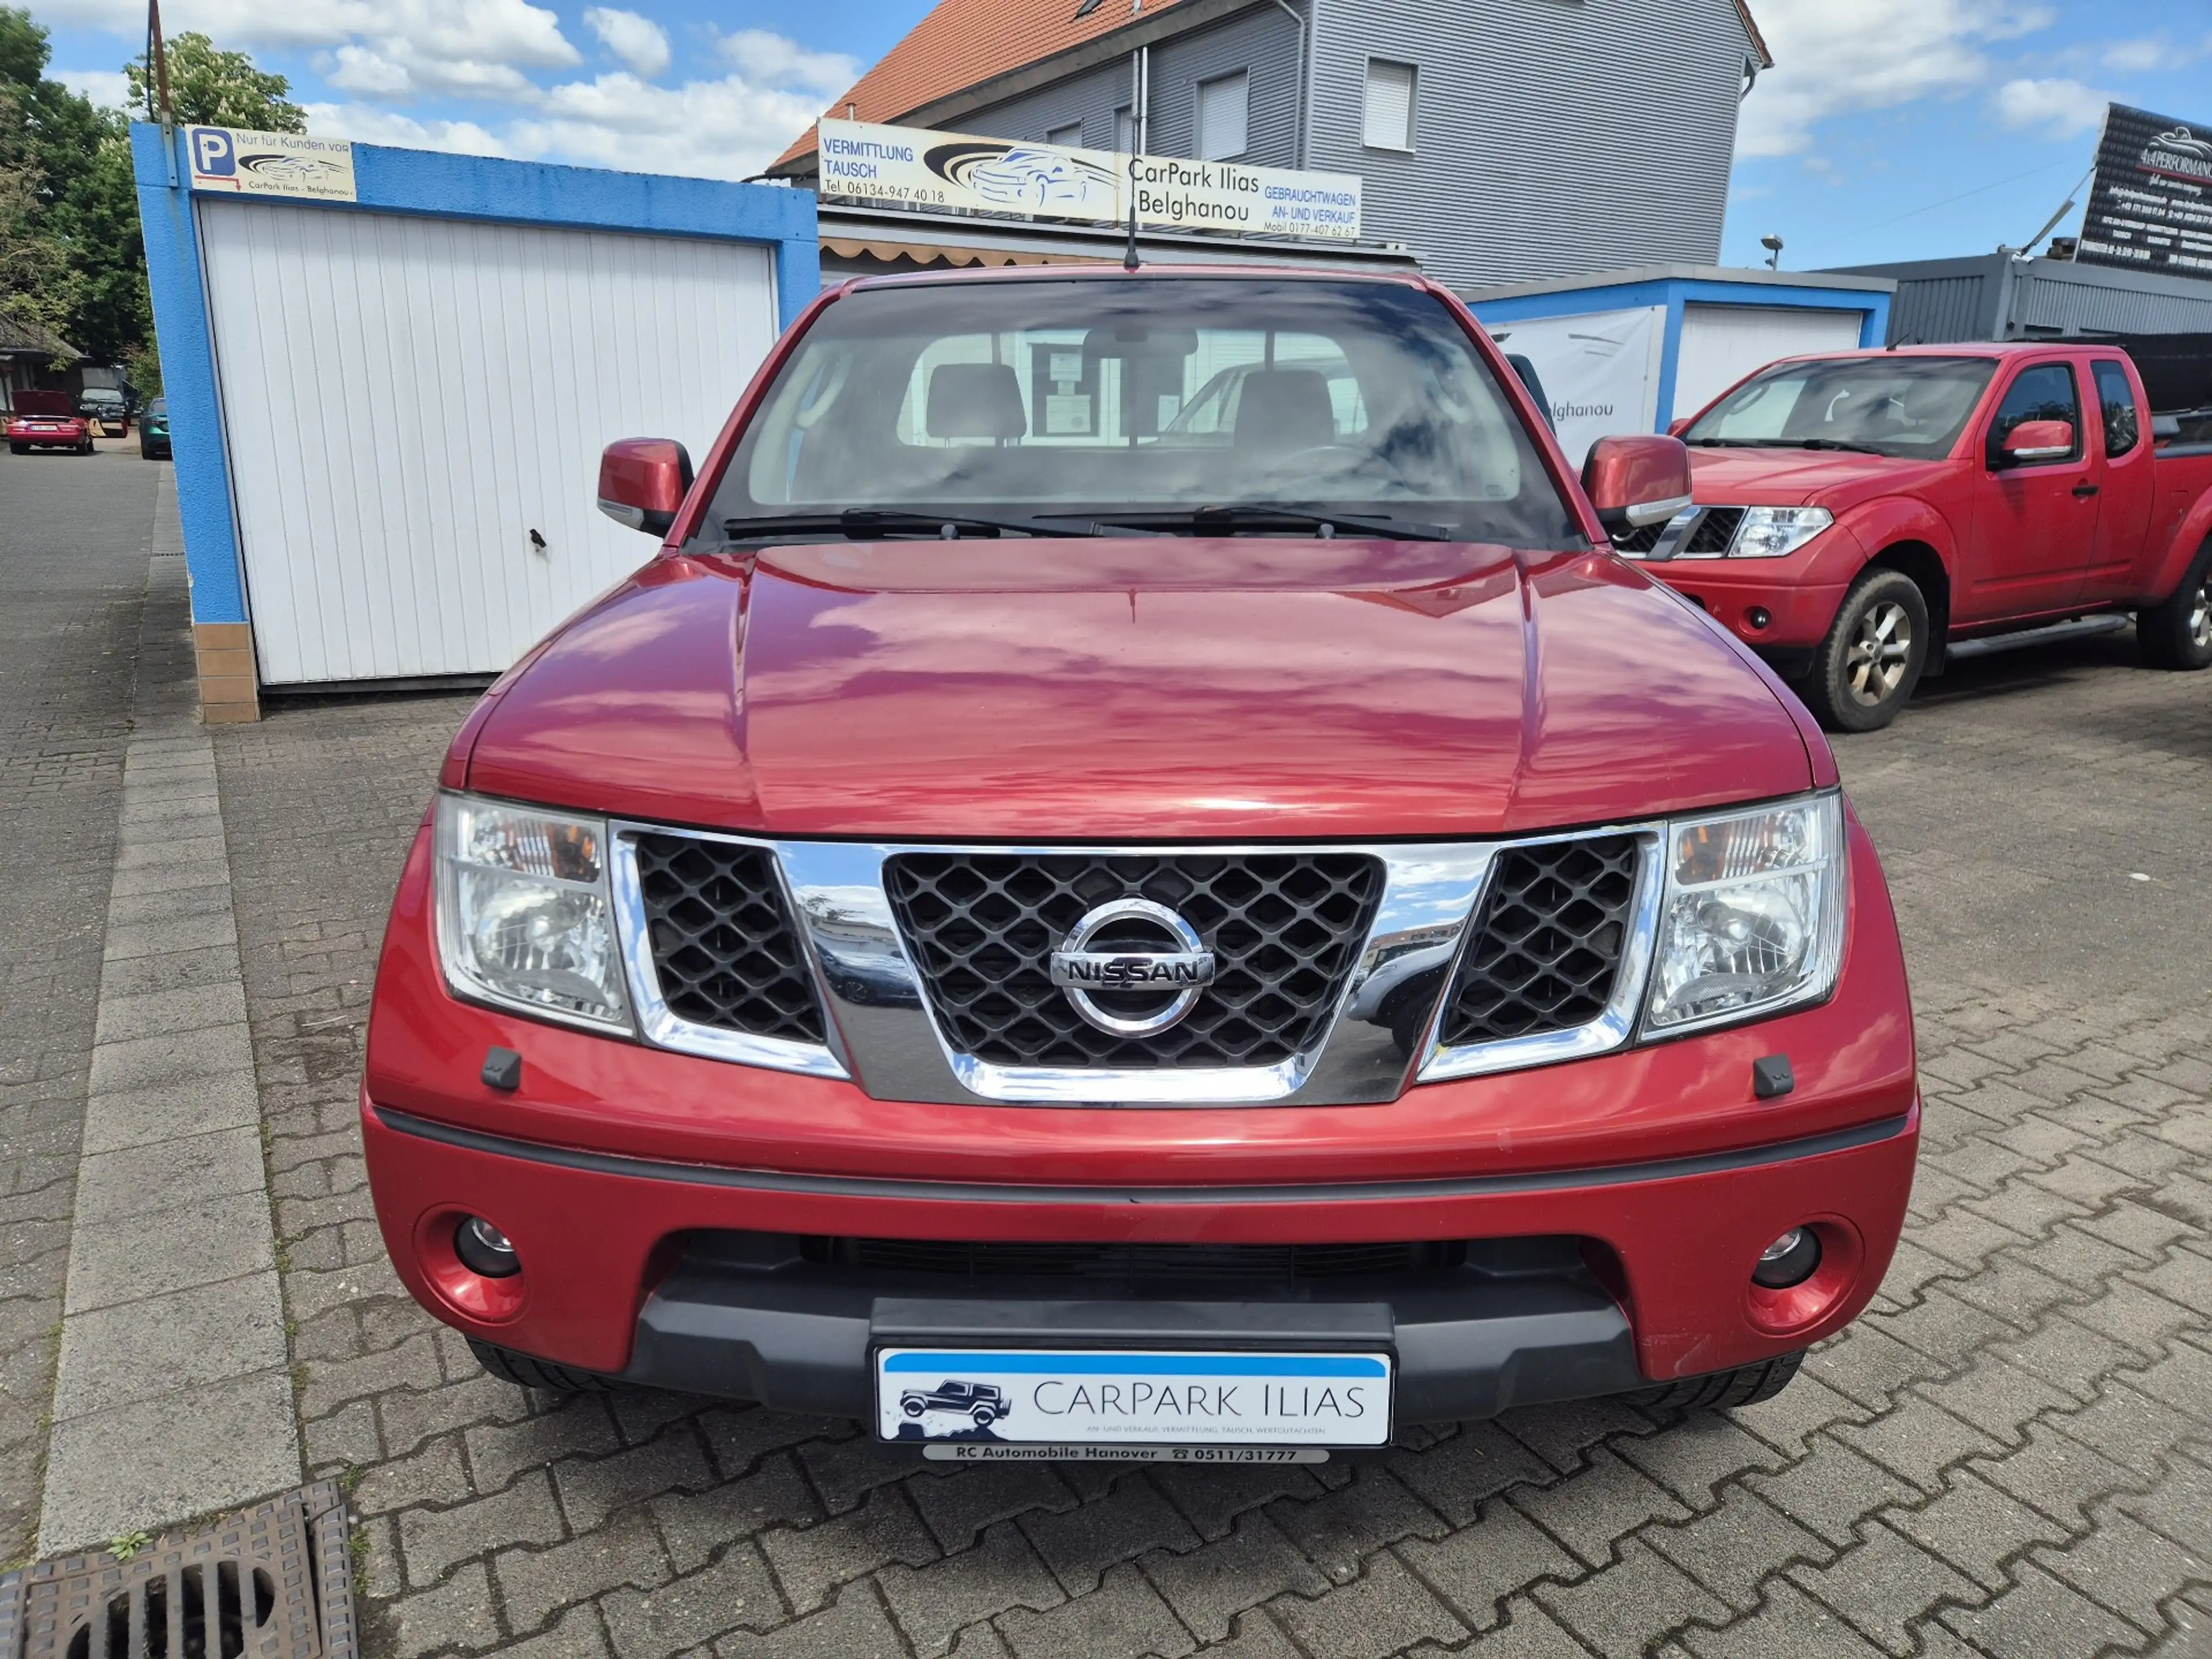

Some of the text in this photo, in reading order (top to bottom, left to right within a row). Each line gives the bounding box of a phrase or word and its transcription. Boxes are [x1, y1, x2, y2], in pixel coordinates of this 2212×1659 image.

[236, 132, 258, 145] Nur
[262, 134, 276, 146] für
[281, 137, 325, 150] Kunden
[823, 138, 914, 162] VERMITTLUNG
[199, 134, 228, 171] P
[824, 160, 877, 179] TAUSCH
[1128, 158, 1259, 192] CarPark Ilias
[248, 180, 281, 190] CarPark
[825, 179, 945, 203] Tel. 06134-947 40 18
[1139, 190, 1249, 221] Belghanou
[1264, 186, 1356, 206] GEBRAUCHTWAGEN
[1272, 205, 1355, 224] AN- UND VERKAUF
[1263, 221, 1355, 237] Mobil 0177-407 62 67
[1552, 401, 1613, 422] lghanou
[1069, 961, 1198, 982] NISSAN
[956, 1446, 1297, 1461] RC Automobile Hanover 0511/31777
